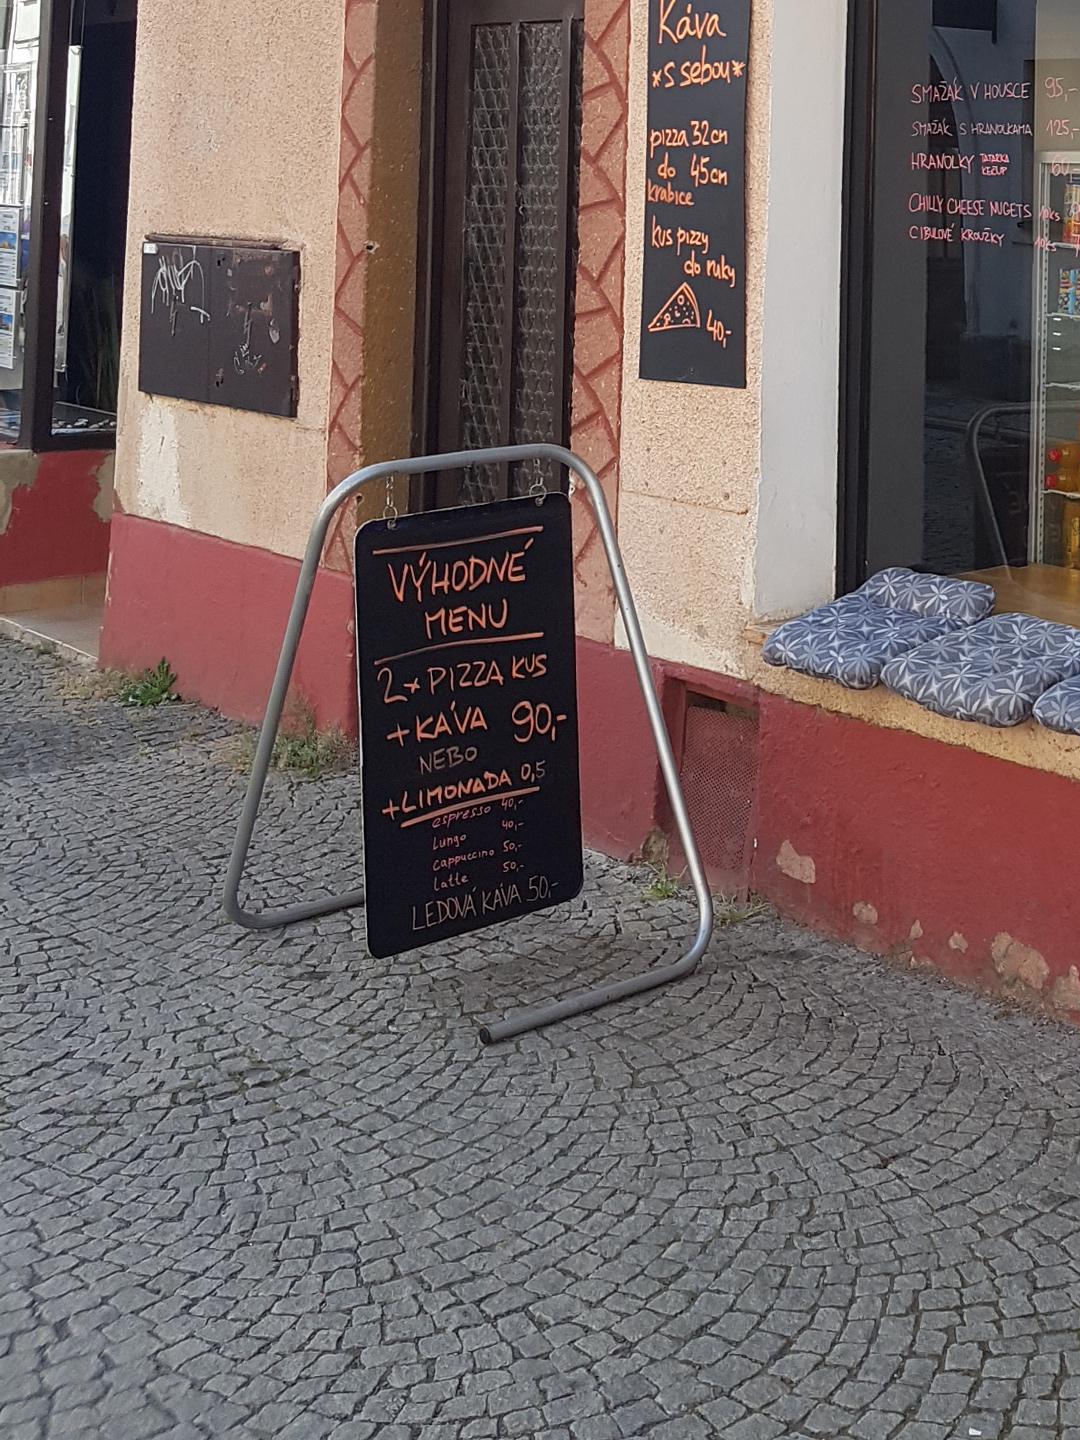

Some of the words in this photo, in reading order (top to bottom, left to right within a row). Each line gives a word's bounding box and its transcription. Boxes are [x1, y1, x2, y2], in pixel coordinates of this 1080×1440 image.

[911, 76, 964, 104] SMAŽÁK
[984, 82, 1031, 100] HOUSCE
[911, 118, 953, 137] SMAŽÁK
[650, 128, 690, 159] pizza
[657, 151, 676, 179] do
[911, 152, 976, 174] HRANOLKY
[647, 178, 695, 206] krabice
[946, 198, 986, 216] CHEESE
[989, 200, 1033, 219] NUGETS
[651, 215, 673, 248] kus
[677, 226, 709, 255] pizzy
[684, 251, 701, 277] do
[706, 255, 737, 288] ruky
[387, 538, 534, 603] VÝHODNÉ
[424, 597, 509, 640] MENU
[427, 660, 504, 695] PIZZA
[512, 653, 547, 679] KUS
[419, 745, 478, 775] NEBO
[520, 760, 548, 784] 0,5
[432, 805, 492, 829] espresso
[432, 834, 467, 850] Lungo
[412, 886, 477, 931] LEDOVÁ
[481, 882, 522, 916] KÁVA
